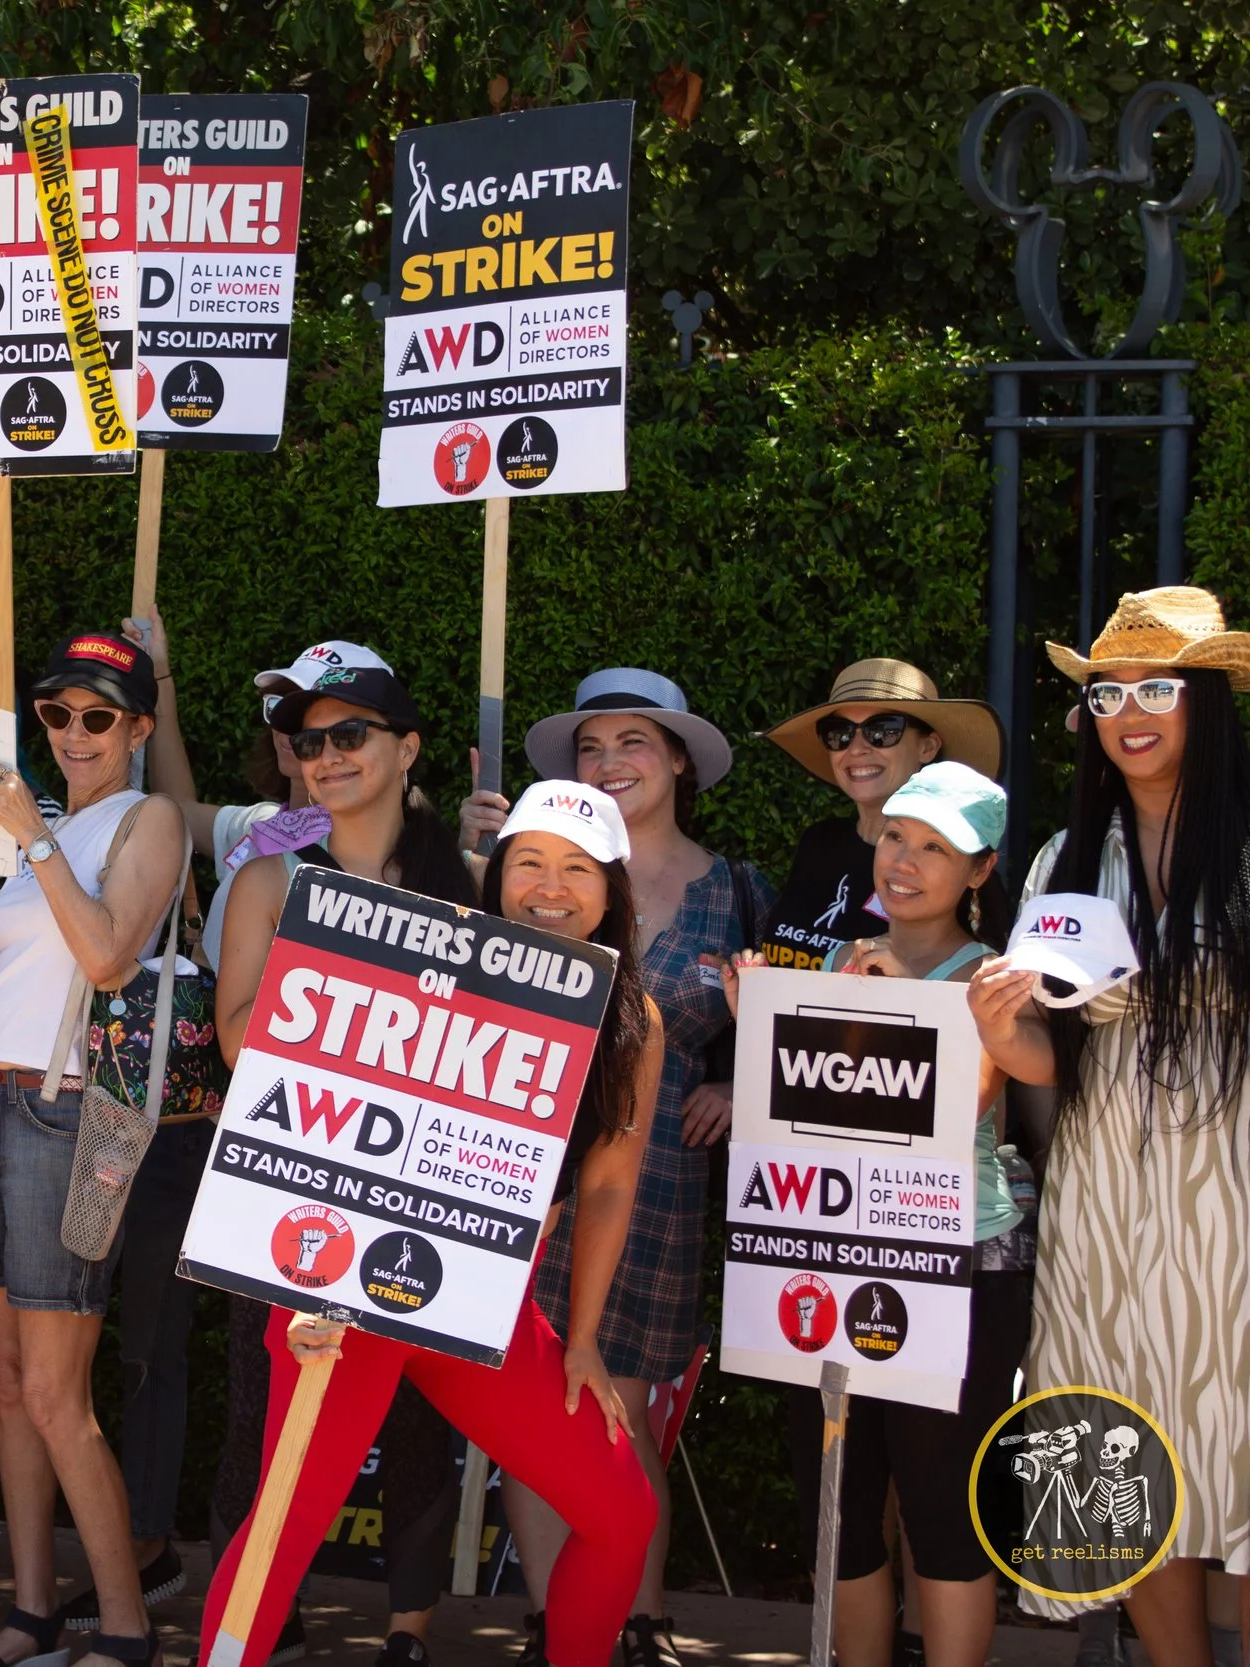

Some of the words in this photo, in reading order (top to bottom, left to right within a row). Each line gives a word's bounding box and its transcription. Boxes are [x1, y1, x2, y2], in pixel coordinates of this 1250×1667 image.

[138, 119, 199, 149] TERS
[205, 119, 289, 150] GUILD
[31, 115, 69, 194] CRIME
[163, 156, 190, 176] ON
[138, 181, 283, 246] RIKE!
[482, 211, 523, 239] ON
[47, 191, 82, 272] SCENE
[191, 264, 282, 278] ALLIANCE
[401, 231, 615, 302] STRIKE!
[22, 289, 45, 303] OF
[63, 270, 90, 309] DO
[190, 282, 212, 295] OF
[217, 283, 280, 296] WOMEN
[22, 305, 120, 322] DIRERS
[189, 300, 280, 313] DIRECTORS
[520, 304, 611, 326] ALLIANCE
[157, 330, 278, 350] SOLIDARITY
[520, 330, 541, 345] OF
[545, 324, 609, 342] WOMEN
[396, 320, 504, 377] AWD
[519, 344, 610, 364] DIRECTORS
[388, 393, 462, 418] STANDS
[467, 389, 485, 409] IN
[490, 377, 610, 406] SOLIDARITY
[170, 408, 213, 418] STRIKE!
[10, 430, 55, 441] STRIKE!
[440, 424, 466, 447] WRITERS
[467, 424, 483, 440] GUILD
[506, 468, 547, 480] STRIKE!
[444, 481, 453, 493] ON
[455, 479, 479, 494] STRIKE
[70, 642, 133, 665] SHAKESPEARE
[304, 646, 343, 665] WD
[540, 794, 593, 818] AWD
[1027, 915, 1082, 936] AWD
[480, 936, 594, 999] GUILD
[418, 968, 457, 1000] ON
[267, 968, 570, 1120] STRIKE!
[778, 1048, 930, 1100] WGAW
[245, 1077, 404, 1157] AWD
[428, 1118, 544, 1163] ALLIANCE
[423, 1139, 453, 1158] OF
[458, 1148, 538, 1183] WOMEN
[417, 1158, 533, 1204] DIRECTORS
[739, 1161, 852, 1217] AWD
[869, 1167, 960, 1190] ALLIANCE
[223, 1143, 329, 1190] STANDS
[334, 1175, 362, 1201] IN
[366, 1185, 524, 1246] SOLIDARITY
[869, 1189, 893, 1205] OF
[898, 1191, 959, 1211] WOMEN
[288, 1206, 326, 1223] WRITERS
[327, 1211, 349, 1234] GUILD
[869, 1209, 961, 1233] DIRECTORS
[731, 1233, 807, 1260] STANDS
[812, 1240, 832, 1262] IN
[837, 1243, 961, 1275] SOLIDARITY
[279, 1264, 295, 1279] ON
[294, 1273, 329, 1287] STRIKE
[391, 1282, 402, 1291] ON
[785, 1275, 811, 1295] WRITERS
[367, 1283, 422, 1308] STRIKE!
[854, 1337, 898, 1352] STRIKE!
